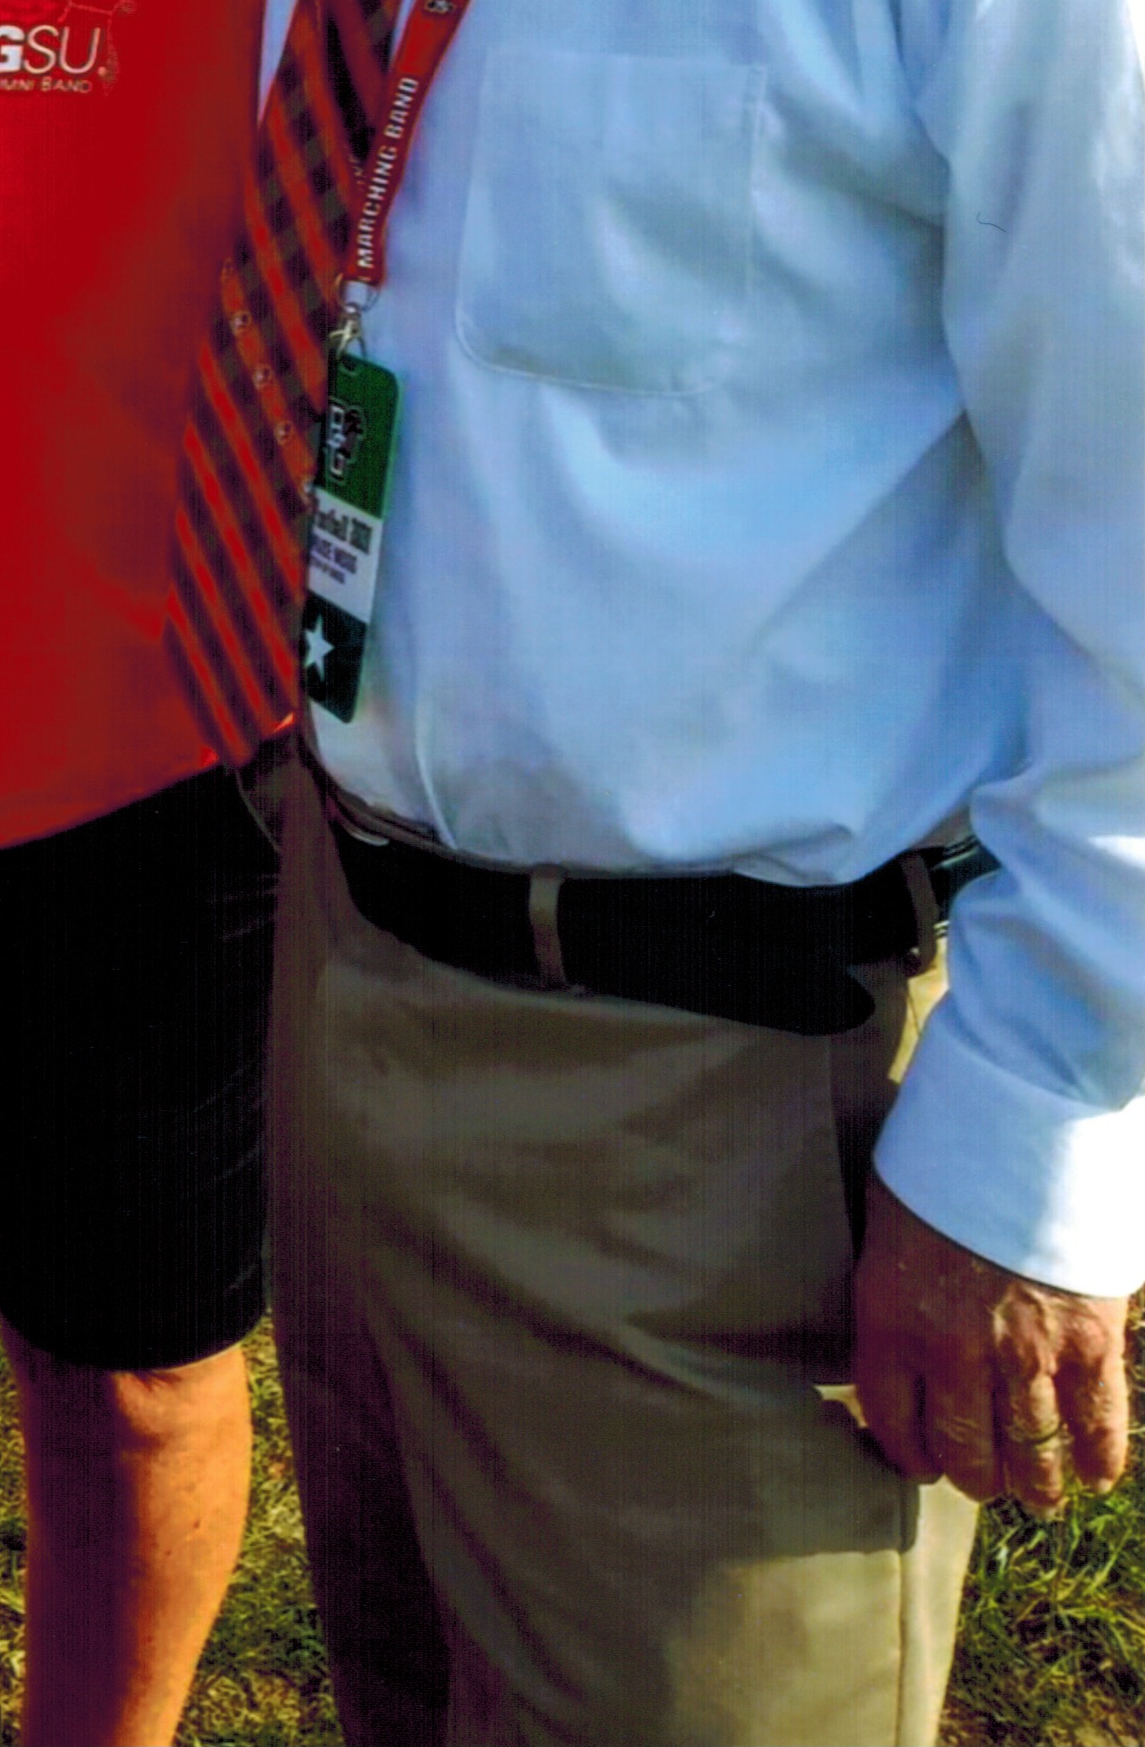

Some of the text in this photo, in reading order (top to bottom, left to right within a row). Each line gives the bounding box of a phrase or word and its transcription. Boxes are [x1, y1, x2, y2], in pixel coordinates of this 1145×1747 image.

[41, 76, 93, 93] BAND
[357, 77, 419, 268] MARCHING BAND
